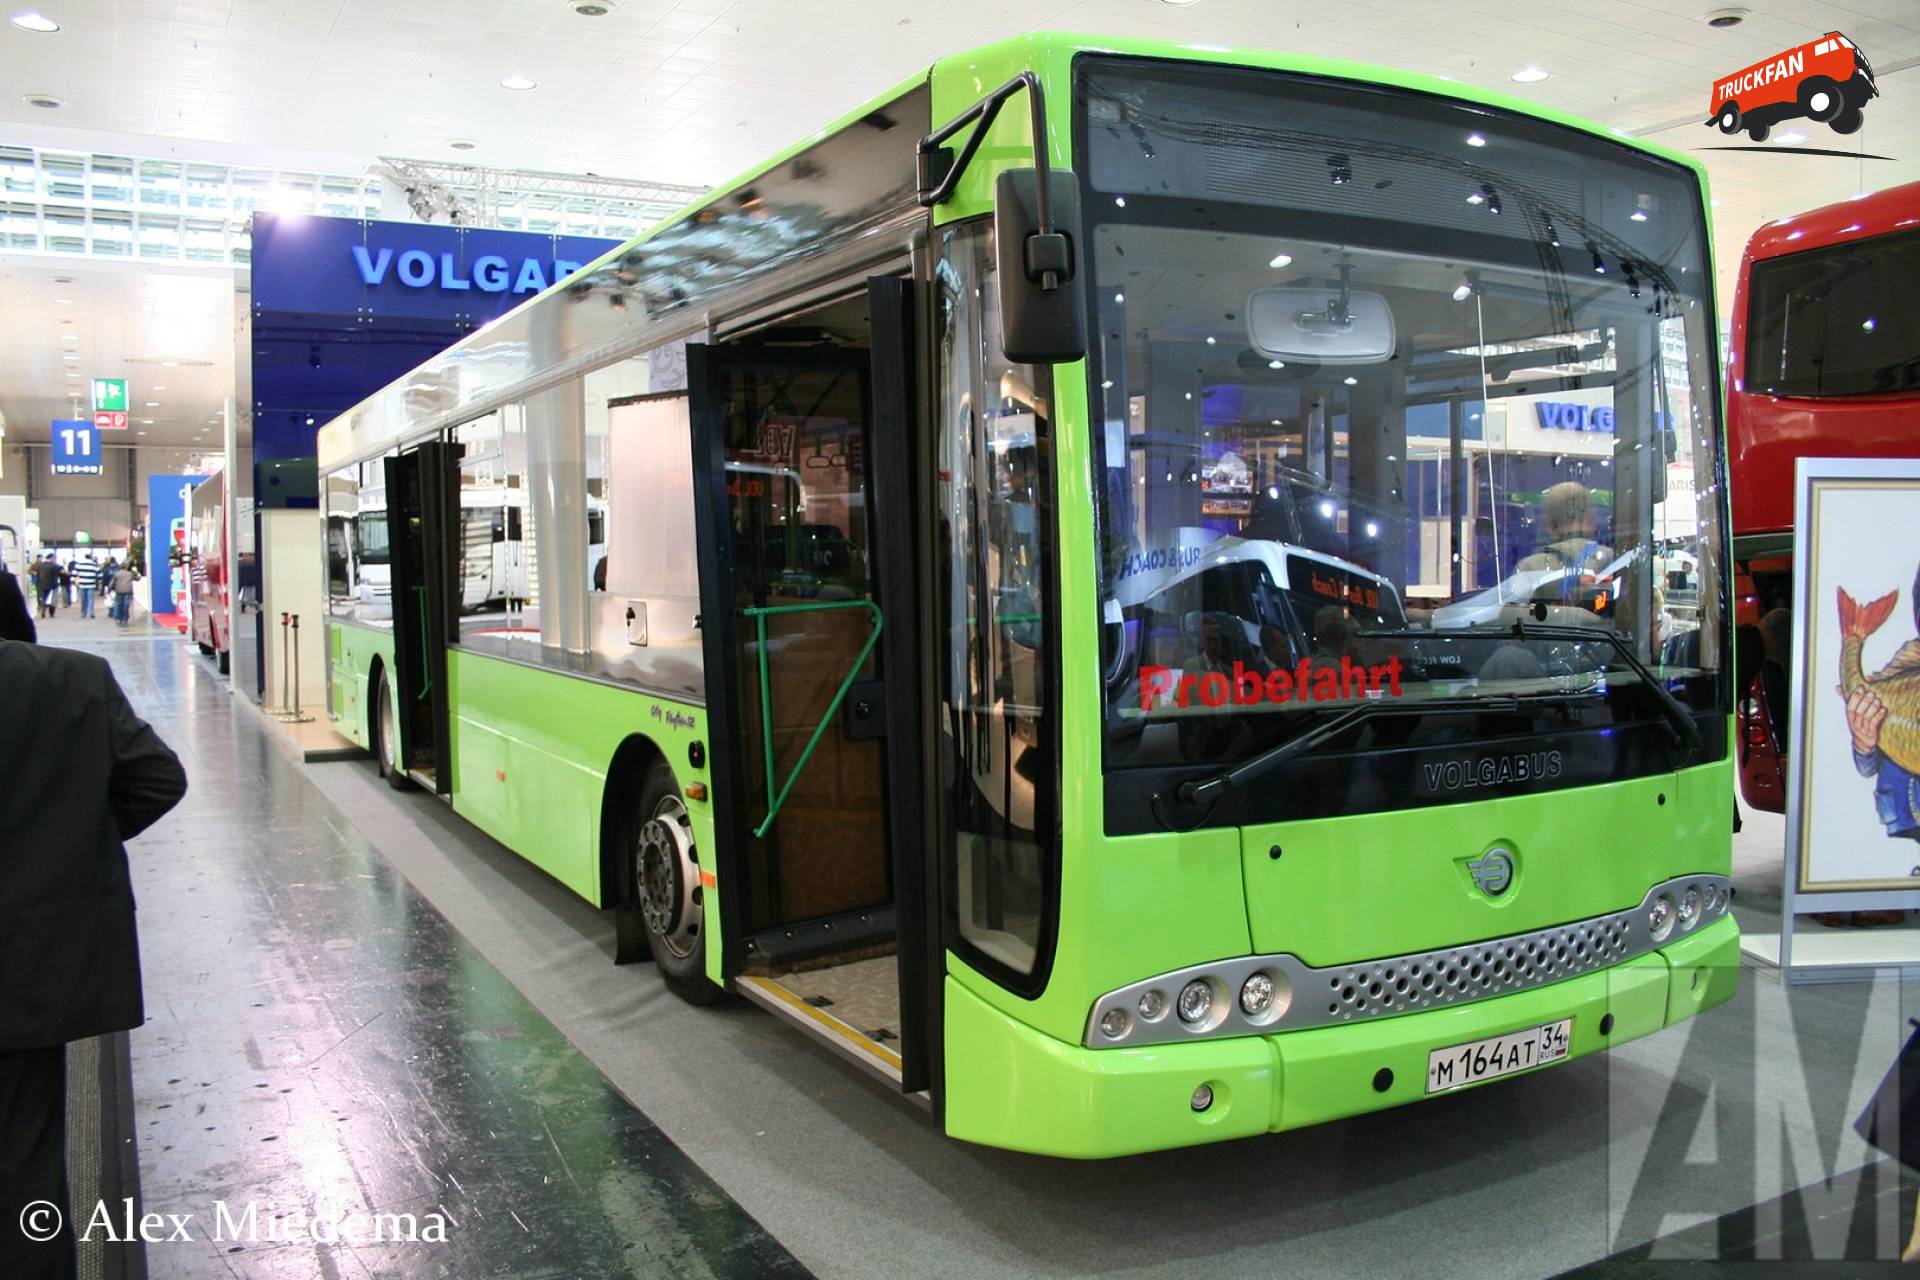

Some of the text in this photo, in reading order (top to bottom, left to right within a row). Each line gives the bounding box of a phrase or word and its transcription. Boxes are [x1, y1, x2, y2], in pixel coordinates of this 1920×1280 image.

[1535, 401, 1614, 433] VOLG
[60, 429, 91, 456] 11
[1139, 655, 1404, 712] Probefahrt
[1424, 750, 1562, 791] VOLGABUS
[1437, 1024, 1563, 1085] M164AT 34
[1540, 1049, 1555, 1060] RUS
